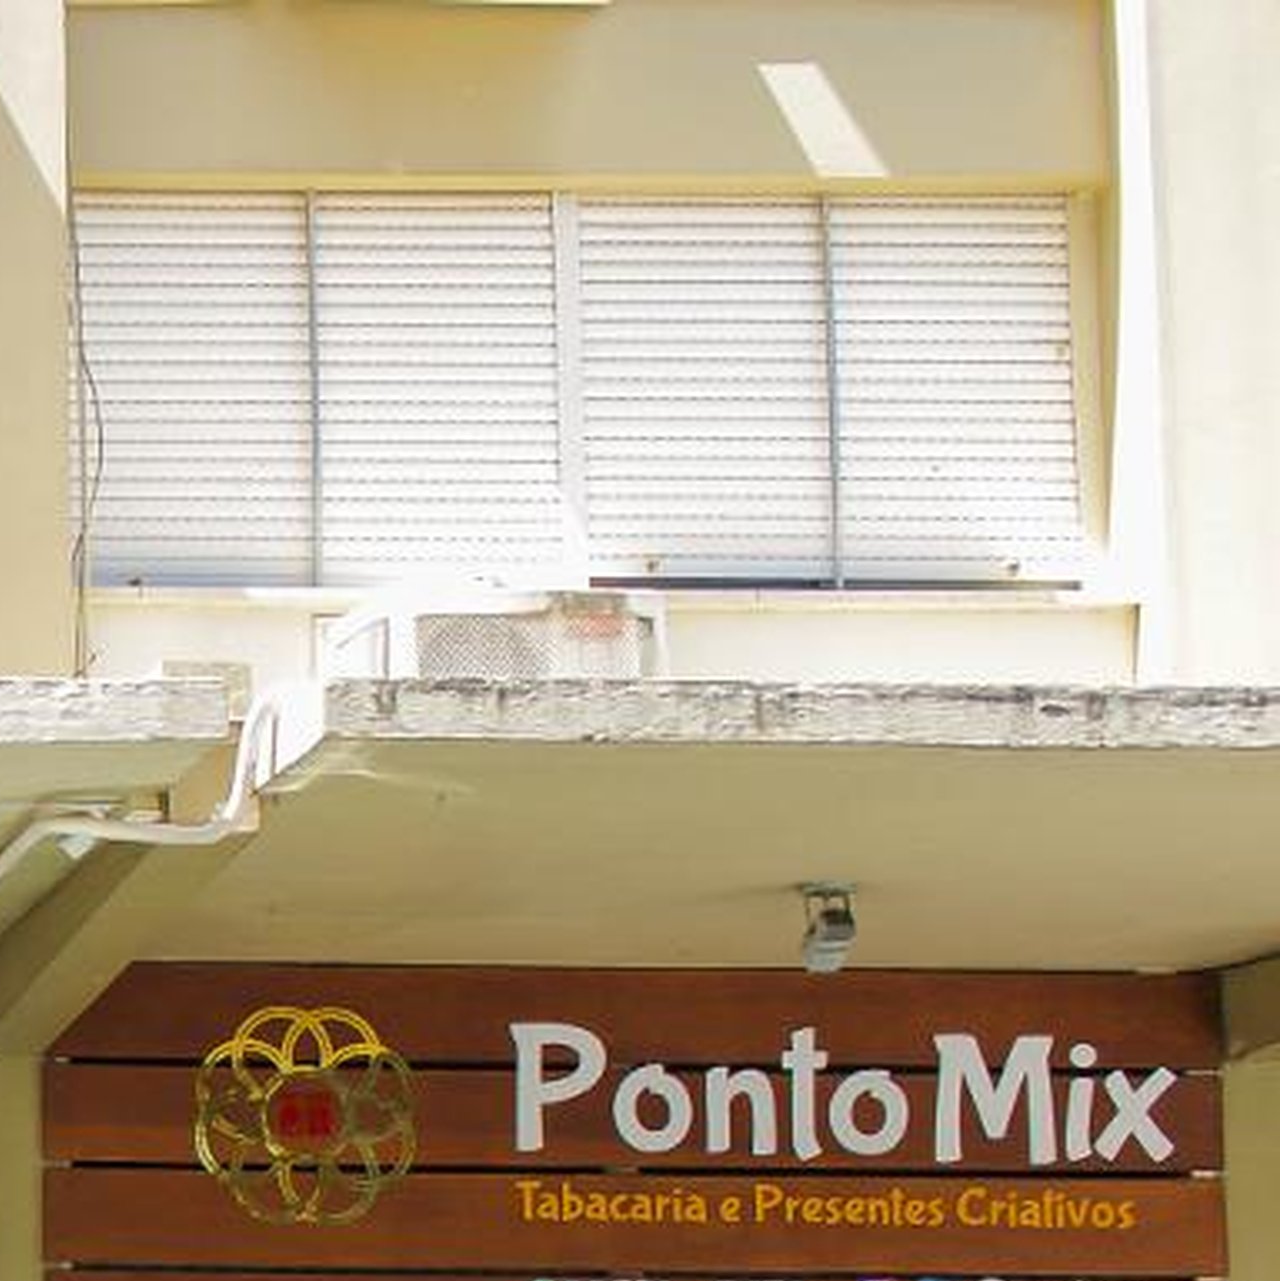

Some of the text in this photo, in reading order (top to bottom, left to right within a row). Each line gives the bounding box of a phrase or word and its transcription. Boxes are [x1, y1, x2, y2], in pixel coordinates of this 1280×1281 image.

[509, 1022, 1177, 1164] Ponto Mix
[515, 1180, 1138, 1229] Tabacaria e Presentes Criativos
